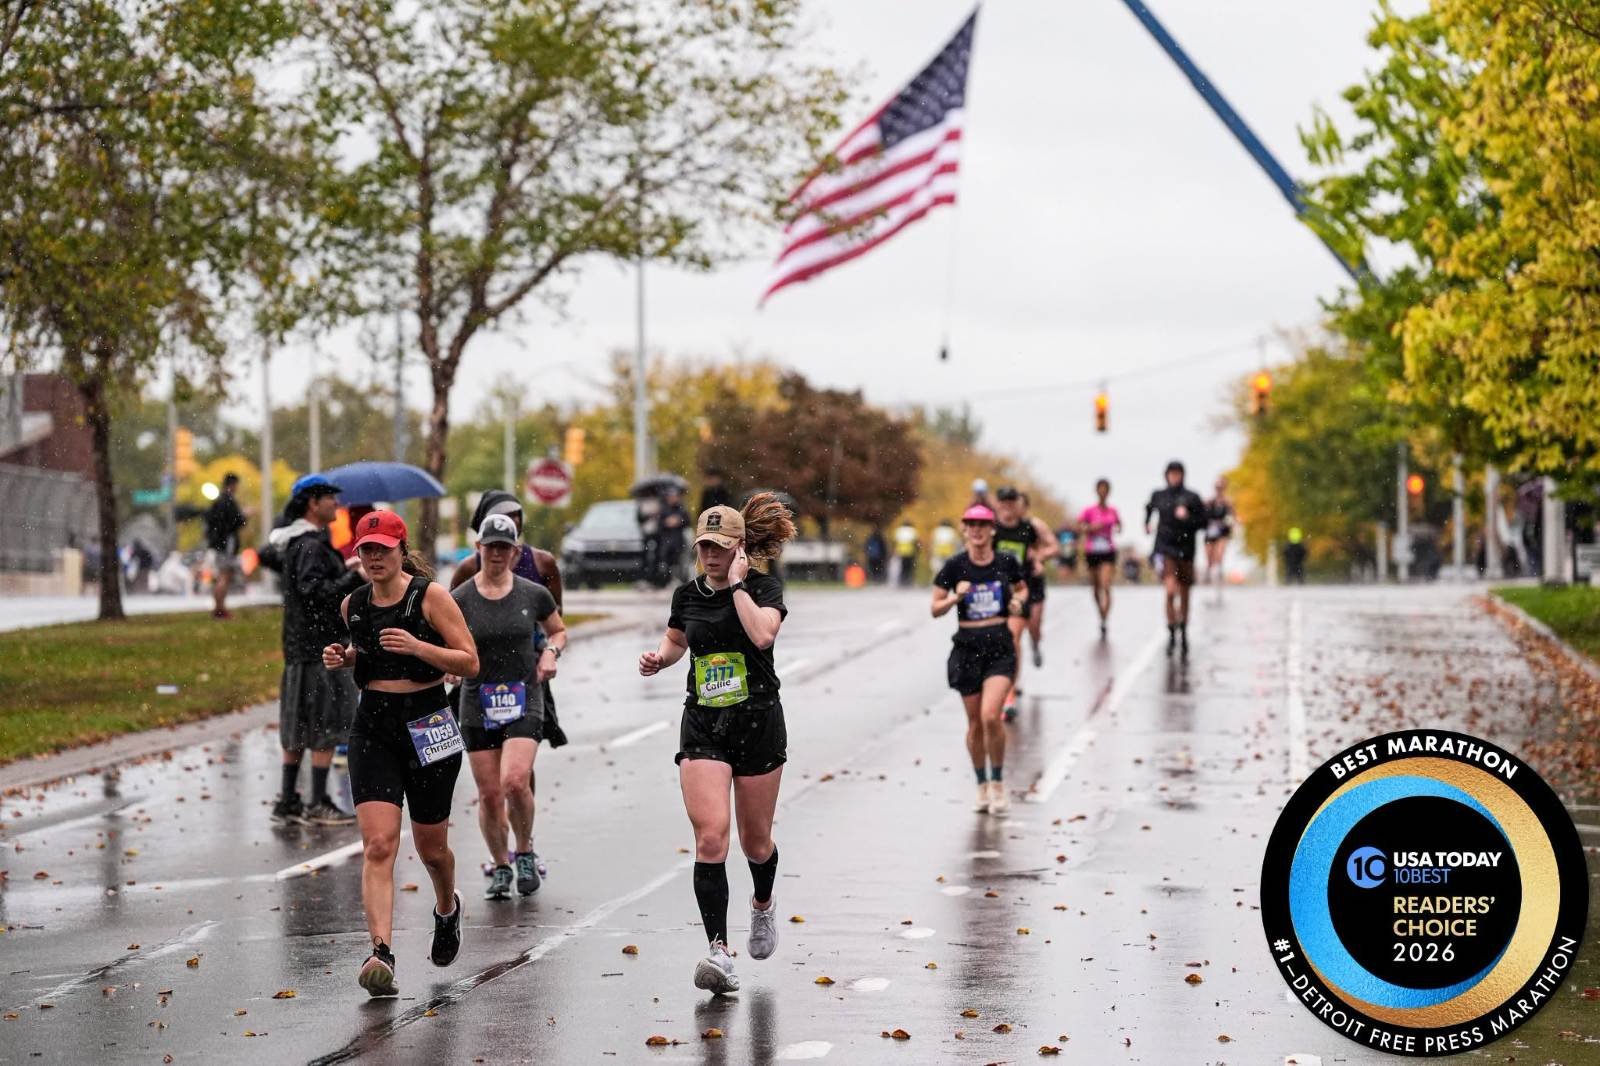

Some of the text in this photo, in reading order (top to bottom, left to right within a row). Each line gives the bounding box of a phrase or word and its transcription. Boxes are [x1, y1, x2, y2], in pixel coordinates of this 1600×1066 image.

[705, 679, 731, 691] Callie
[490, 693, 516, 707] 1140
[425, 723, 454, 744] 1059
[424, 737, 461, 756] Christine
